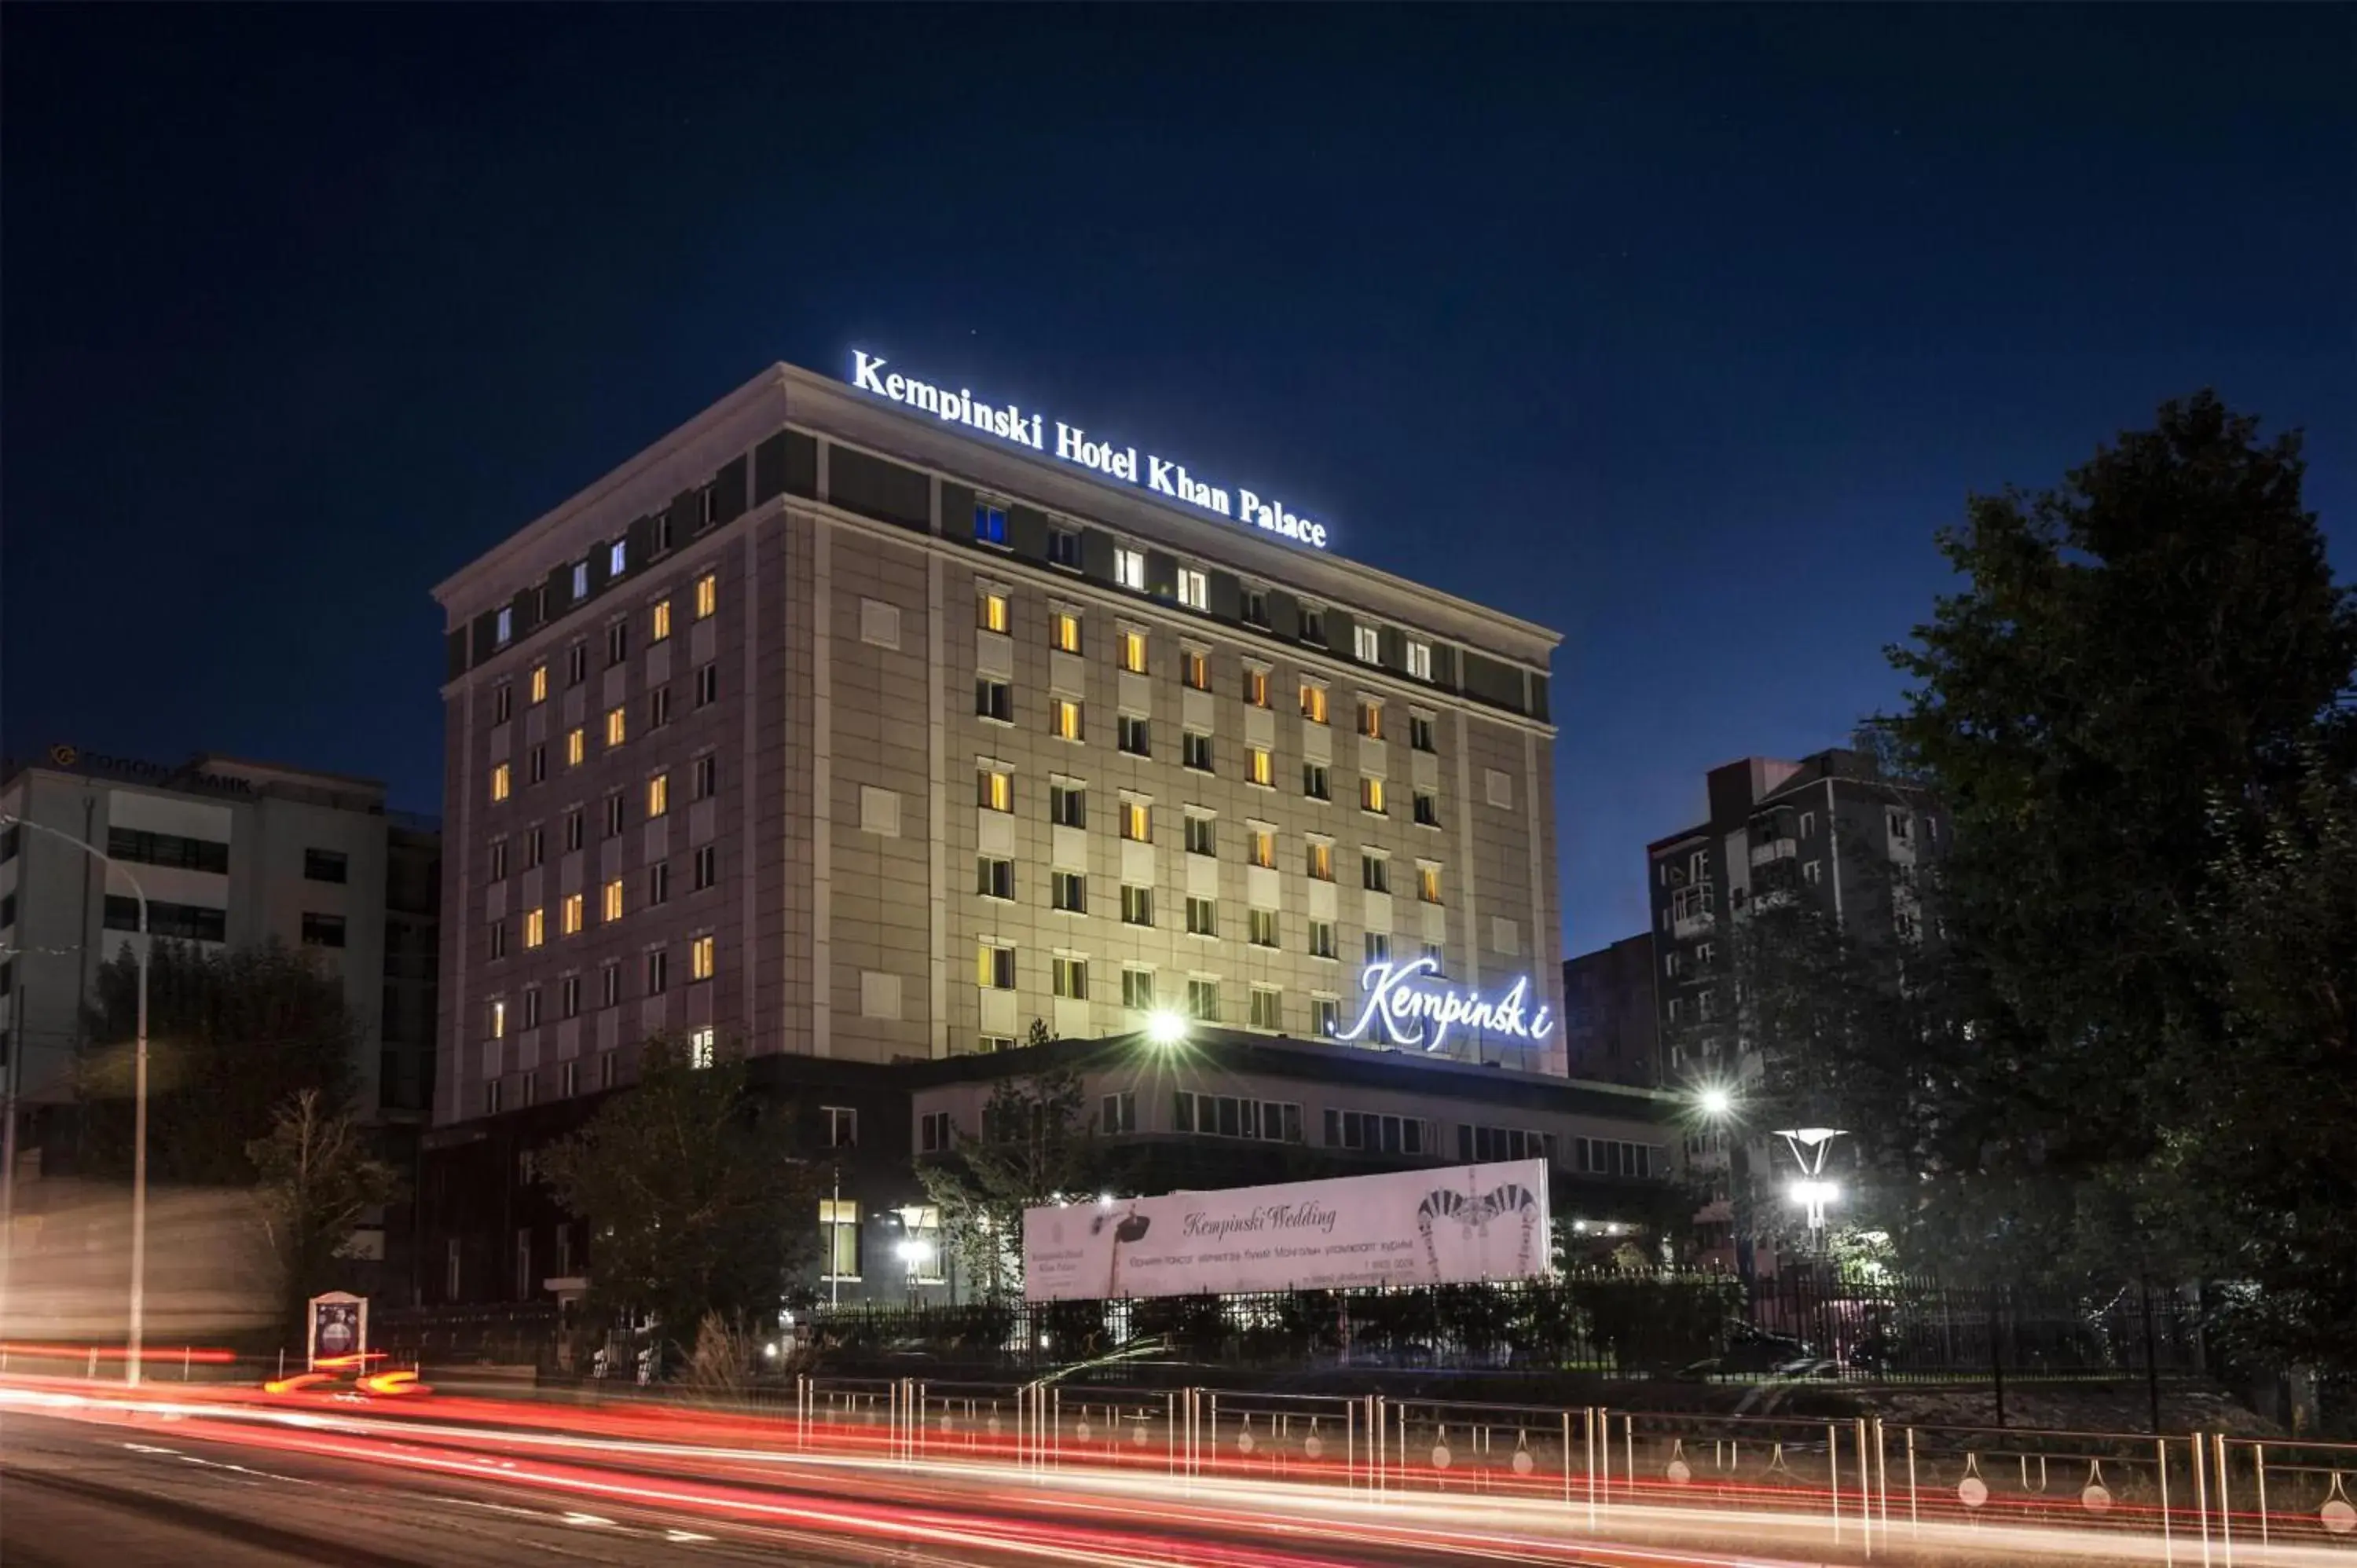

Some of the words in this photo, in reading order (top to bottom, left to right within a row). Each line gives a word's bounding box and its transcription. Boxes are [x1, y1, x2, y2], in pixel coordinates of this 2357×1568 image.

[852, 350, 1043, 450] Kempinski
[1056, 422, 1138, 482] Hotel
[1148, 455, 1230, 515] Khan
[1239, 489, 1326, 548] Palace
[1328, 958, 1554, 1051] Kempinski
[1183, 1206, 1266, 1242] Kempinski
[1266, 1199, 1337, 1233] Wedding
